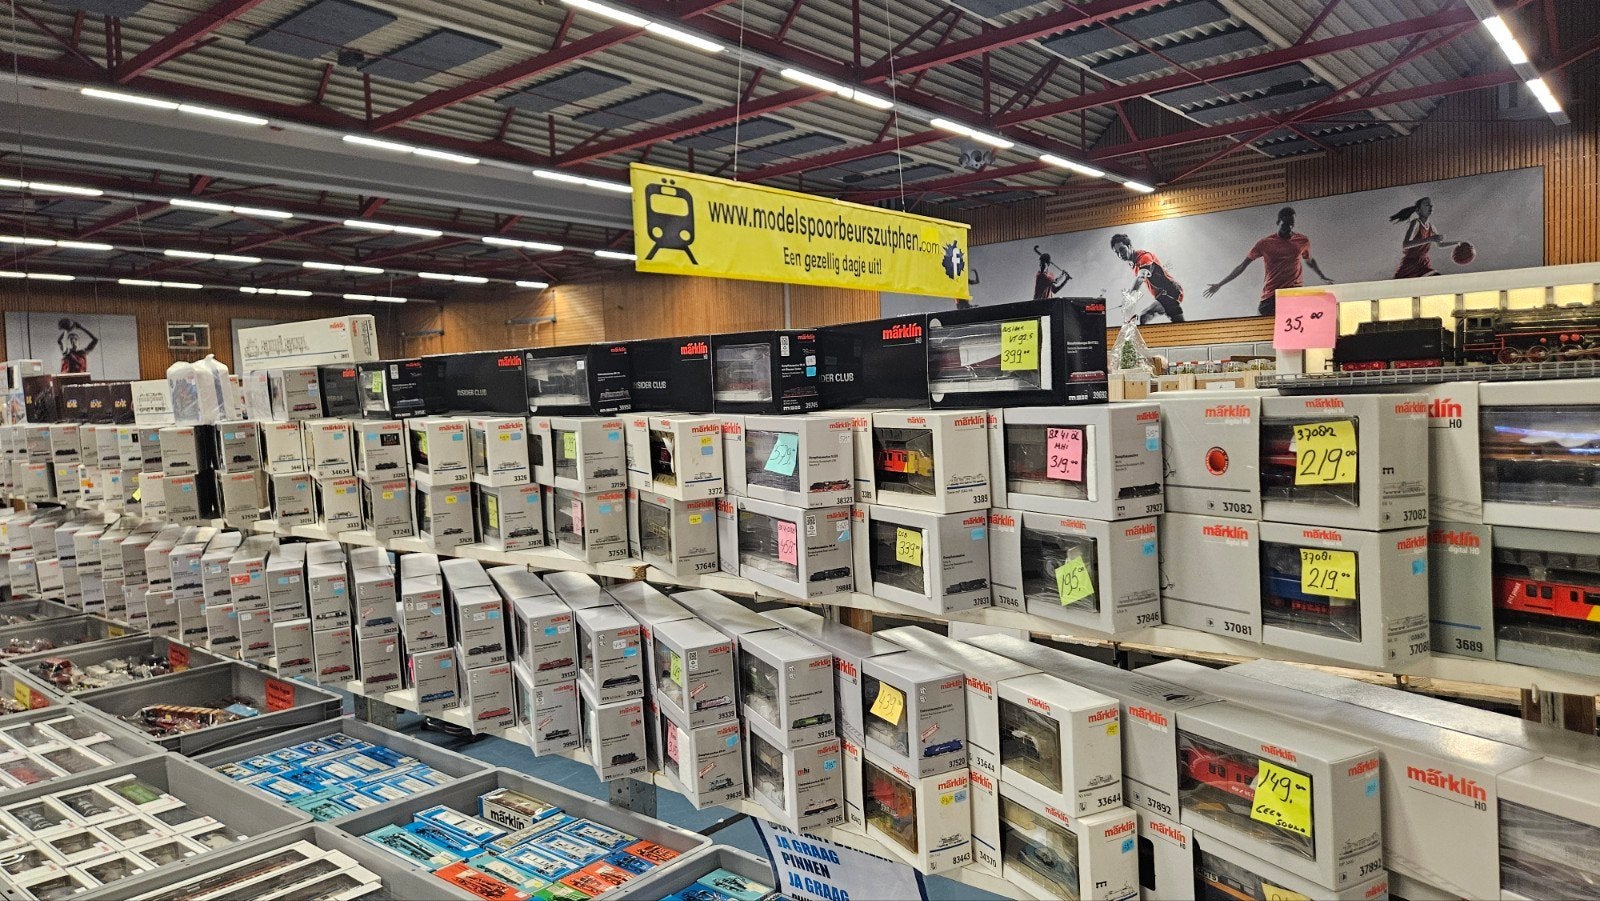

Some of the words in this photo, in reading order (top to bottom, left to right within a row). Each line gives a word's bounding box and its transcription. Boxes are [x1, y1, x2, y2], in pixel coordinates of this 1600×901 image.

[708, 199, 940, 255] www.modelspoorbeurszutphen.com
[783, 246, 802, 266] Een
[804, 249, 840, 275] gezellig
[842, 253, 866, 277] dagje
[867, 256, 882, 275] uit!
[1086, 304, 1105, 312] märklin
[882, 323, 923, 340] märklin
[680, 342, 708, 356] märklin
[497, 355, 522, 368] märklin
[835, 373, 854, 382] CLUB
[652, 381, 666, 389] CLUB
[1305, 398, 1344, 409] märklin
[1394, 402, 1427, 415] märklin
[1136, 411, 1160, 422] märklin
[1205, 403, 1250, 418] märklin
[602, 422, 622, 430] märklin
[829, 420, 852, 430] märklin
[907, 416, 926, 425] märklin
[954, 415, 985, 427] märklin
[1449, 419, 1462, 428] H0
[438, 423, 464, 432] märklin
[498, 423, 523, 432] märklin
[691, 424, 720, 434] märklin
[1297, 425, 1336, 441] 37082
[333, 479, 356, 487] märklin
[520, 486, 540, 494] märklin
[708, 487, 722, 496] 3372
[597, 492, 624, 502] märklin
[687, 500, 714, 510] märklin
[1222, 502, 1252, 513] 37082
[826, 511, 849, 520] märklin
[963, 515, 986, 525] märklin
[1403, 508, 1427, 521] 37082
[1060, 519, 1087, 530] märklin
[1125, 523, 1156, 537] märklin
[1203, 524, 1249, 540] märklin
[1302, 528, 1342, 542] märklin
[1397, 537, 1427, 550] märklin
[694, 562, 716, 571] 37646
[480, 603, 500, 611] märklin
[550, 614, 571, 623] märklin
[1136, 612, 1159, 625] 37846
[617, 628, 639, 638] märklin
[1224, 622, 1252, 636] 37081
[708, 646, 730, 656] märklin
[1455, 638, 1483, 653] 3689
[809, 659, 832, 669] märklin
[553, 684, 574, 693] märklin
[940, 680, 962, 691] märklin
[965, 677, 993, 695] märklin
[619, 705, 641, 715] märklin
[1027, 697, 1051, 712] märklin
[1088, 707, 1119, 724] märklin
[1129, 705, 1168, 727] märklin
[716, 726, 738, 737] märklin
[817, 744, 839, 756] märklin
[1260, 744, 1297, 763] märklin
[976, 757, 995, 773] 33644
[1347, 758, 1379, 778] märklin
[892, 765, 910, 781] märklin
[938, 777, 968, 791] märklin
[1407, 765, 1487, 802] märklin
[1097, 793, 1121, 808] 33644
[1147, 797, 1172, 816] 37892
[1474, 800, 1487, 812] H0
[490, 810, 525, 830] märklin
[1045, 806, 1069, 824] märklin
[1104, 821, 1135, 839] märklin
[1149, 821, 1186, 844] märklin
[775, 834, 790, 850] JA
[791, 836, 841, 865] GRAAG
[781, 851, 831, 878] PINNEN
[952, 852, 970, 865] 83443
[979, 851, 997, 868] 34370
[788, 872, 804, 890] JA
[805, 874, 850, 901] GRAAG
[1365, 882, 1387, 899] märklin
